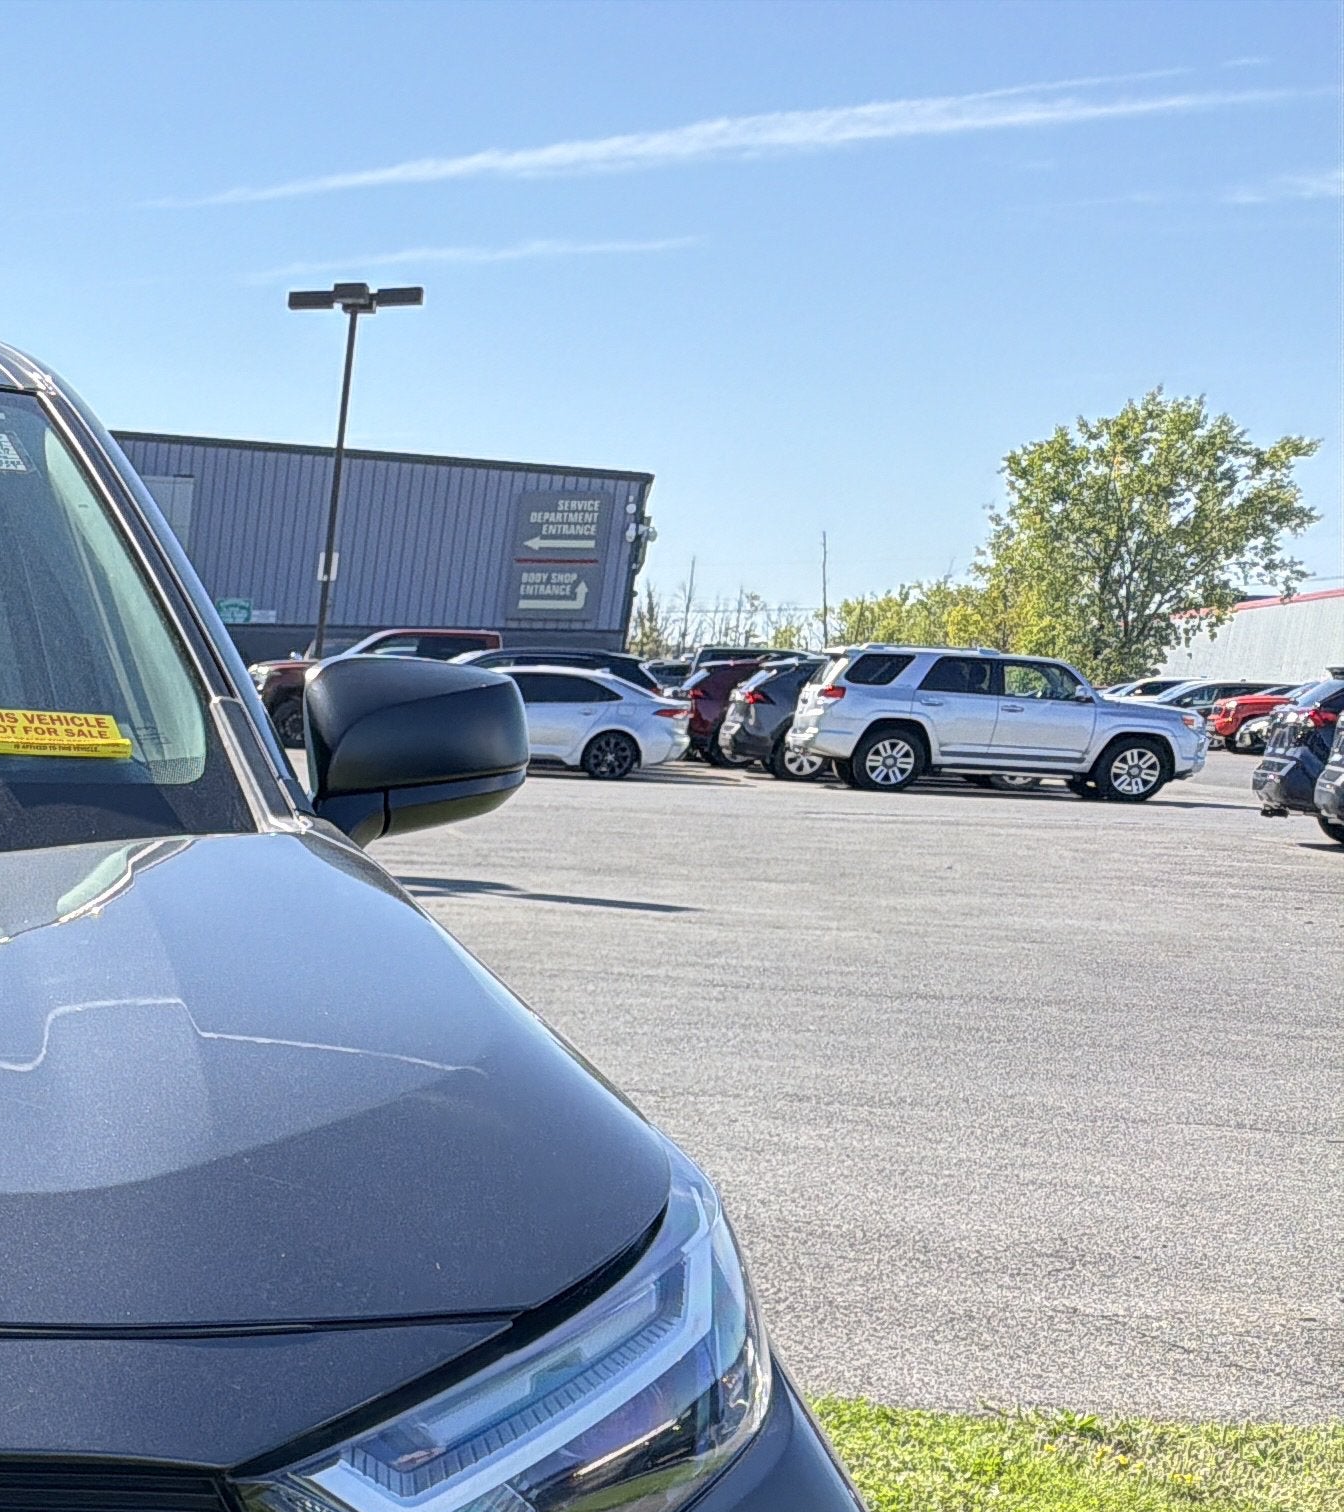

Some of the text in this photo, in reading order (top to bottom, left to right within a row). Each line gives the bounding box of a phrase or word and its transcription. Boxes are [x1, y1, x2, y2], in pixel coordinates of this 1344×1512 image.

[557, 500, 600, 511] SERVICE
[530, 512, 599, 523] DEPARTMENT
[541, 524, 597, 535] ENTRANCE
[521, 573, 578, 584] BODY SHOP
[519, 585, 572, 596] ENTRANCE
[22, 713, 109, 728] VEHICLE
[23, 726, 59, 737] FOR
[64, 728, 110, 739] SALE
